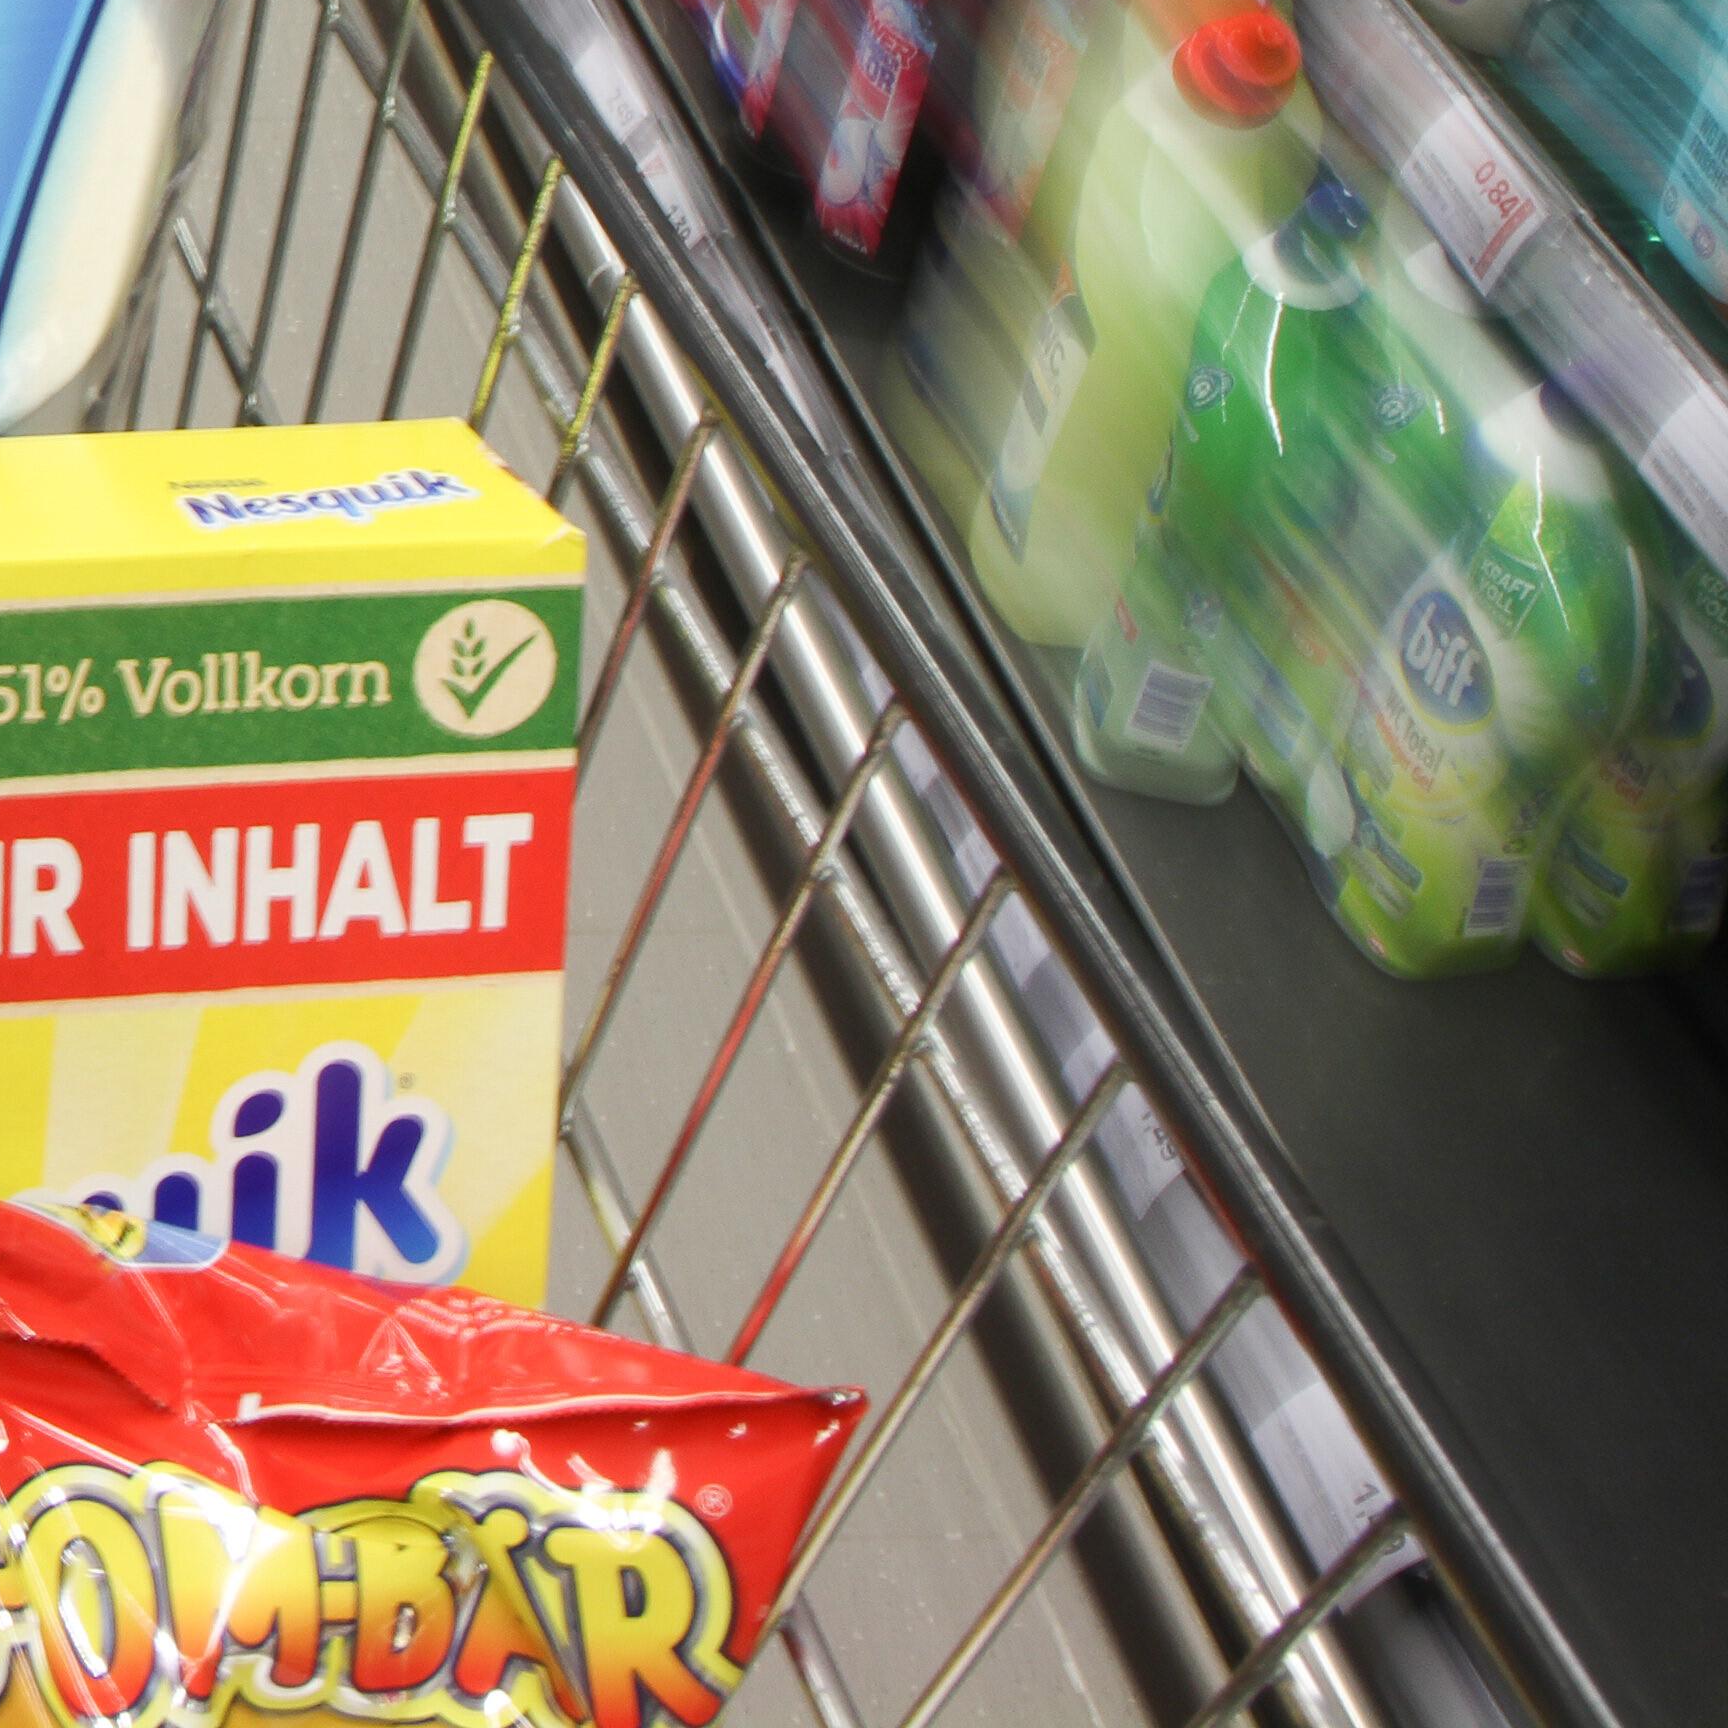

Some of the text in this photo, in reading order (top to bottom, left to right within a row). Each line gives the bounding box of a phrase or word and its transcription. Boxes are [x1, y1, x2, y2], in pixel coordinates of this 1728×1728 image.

[1474, 159, 1521, 220] 0,84
[181, 470, 471, 528] Nesquik
[1480, 559, 1536, 601] KRAFT
[116, 649, 392, 718] Vollkorn
[1407, 601, 1483, 708] biff
[124, 812, 536, 952] INHALT
